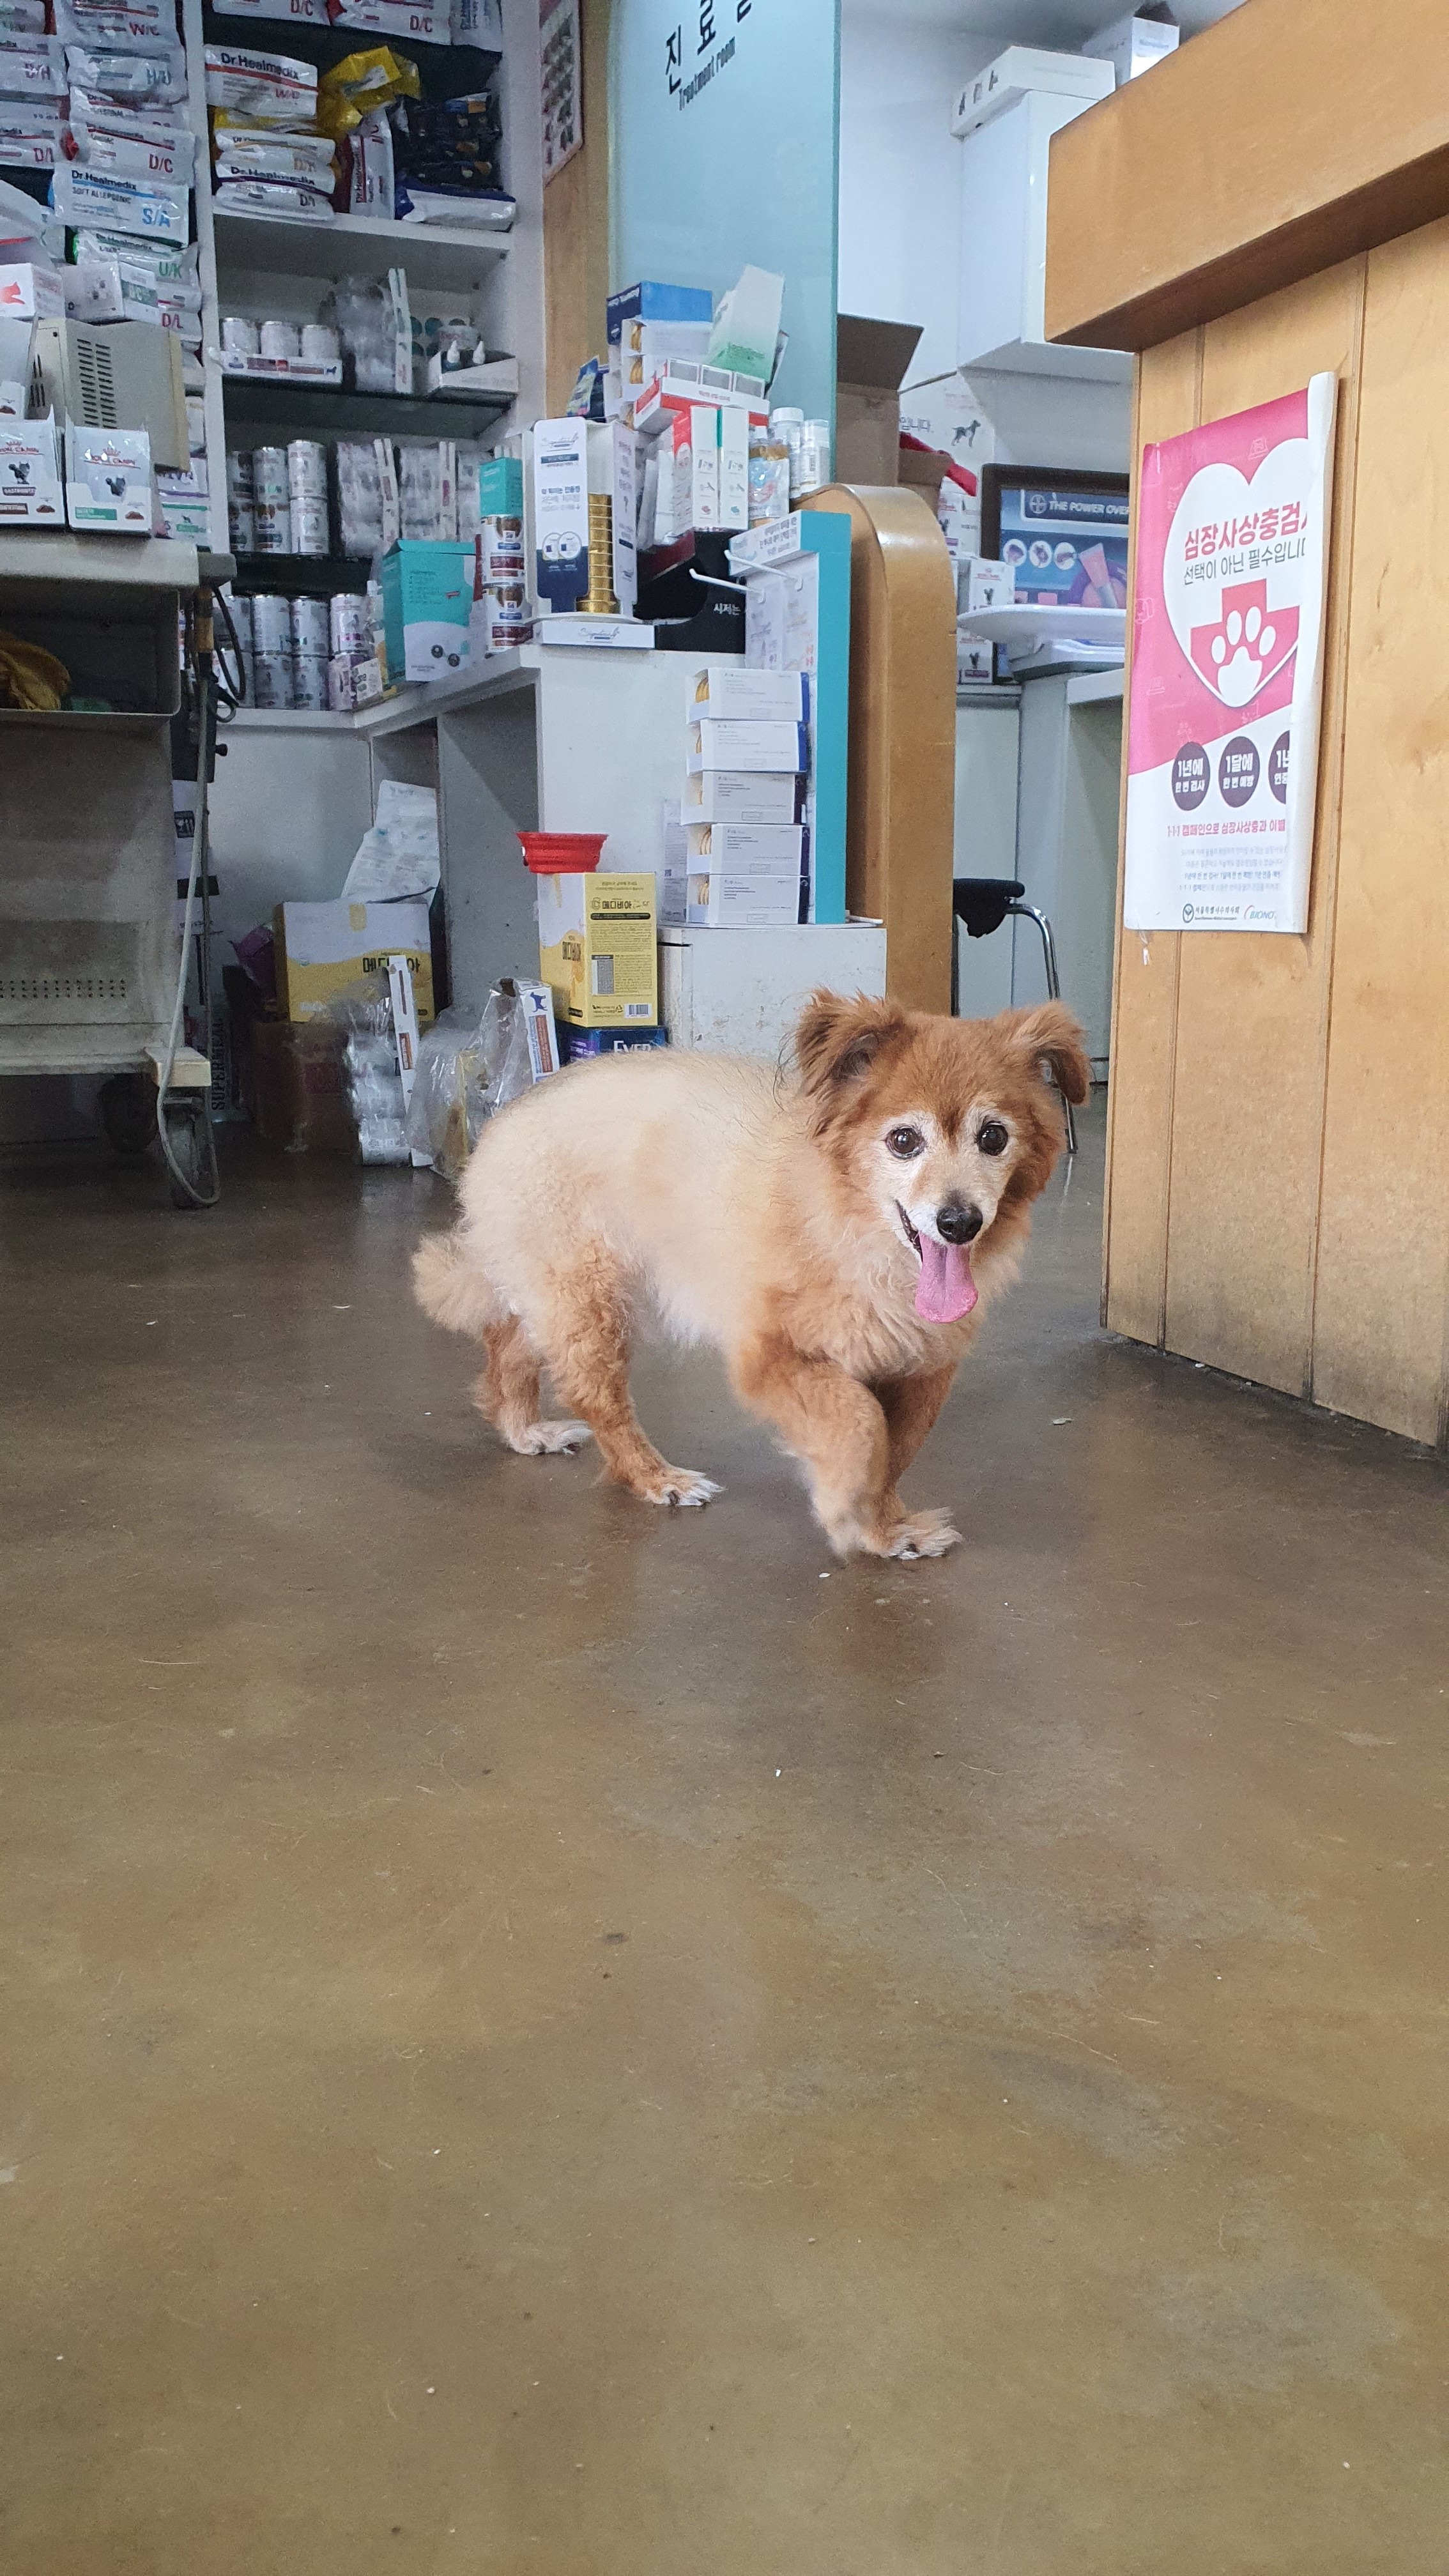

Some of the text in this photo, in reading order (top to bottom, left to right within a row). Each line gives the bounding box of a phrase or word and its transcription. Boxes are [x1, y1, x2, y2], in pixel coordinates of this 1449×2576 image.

[410, 15, 433, 33] D/C
[148, 153, 174, 173] D/C
[142, 207, 171, 228] S/A
[1048, 500, 1068, 510] THE
[1069, 502, 1105, 514] POWER
[1184, 501, 1308, 562] 심장사상충검
[1183, 561, 1217, 586] 선택이
[1220, 552, 1245, 576] 아닌
[1177, 757, 1204, 778] 1년에
[1225, 753, 1254, 774] 1달에
